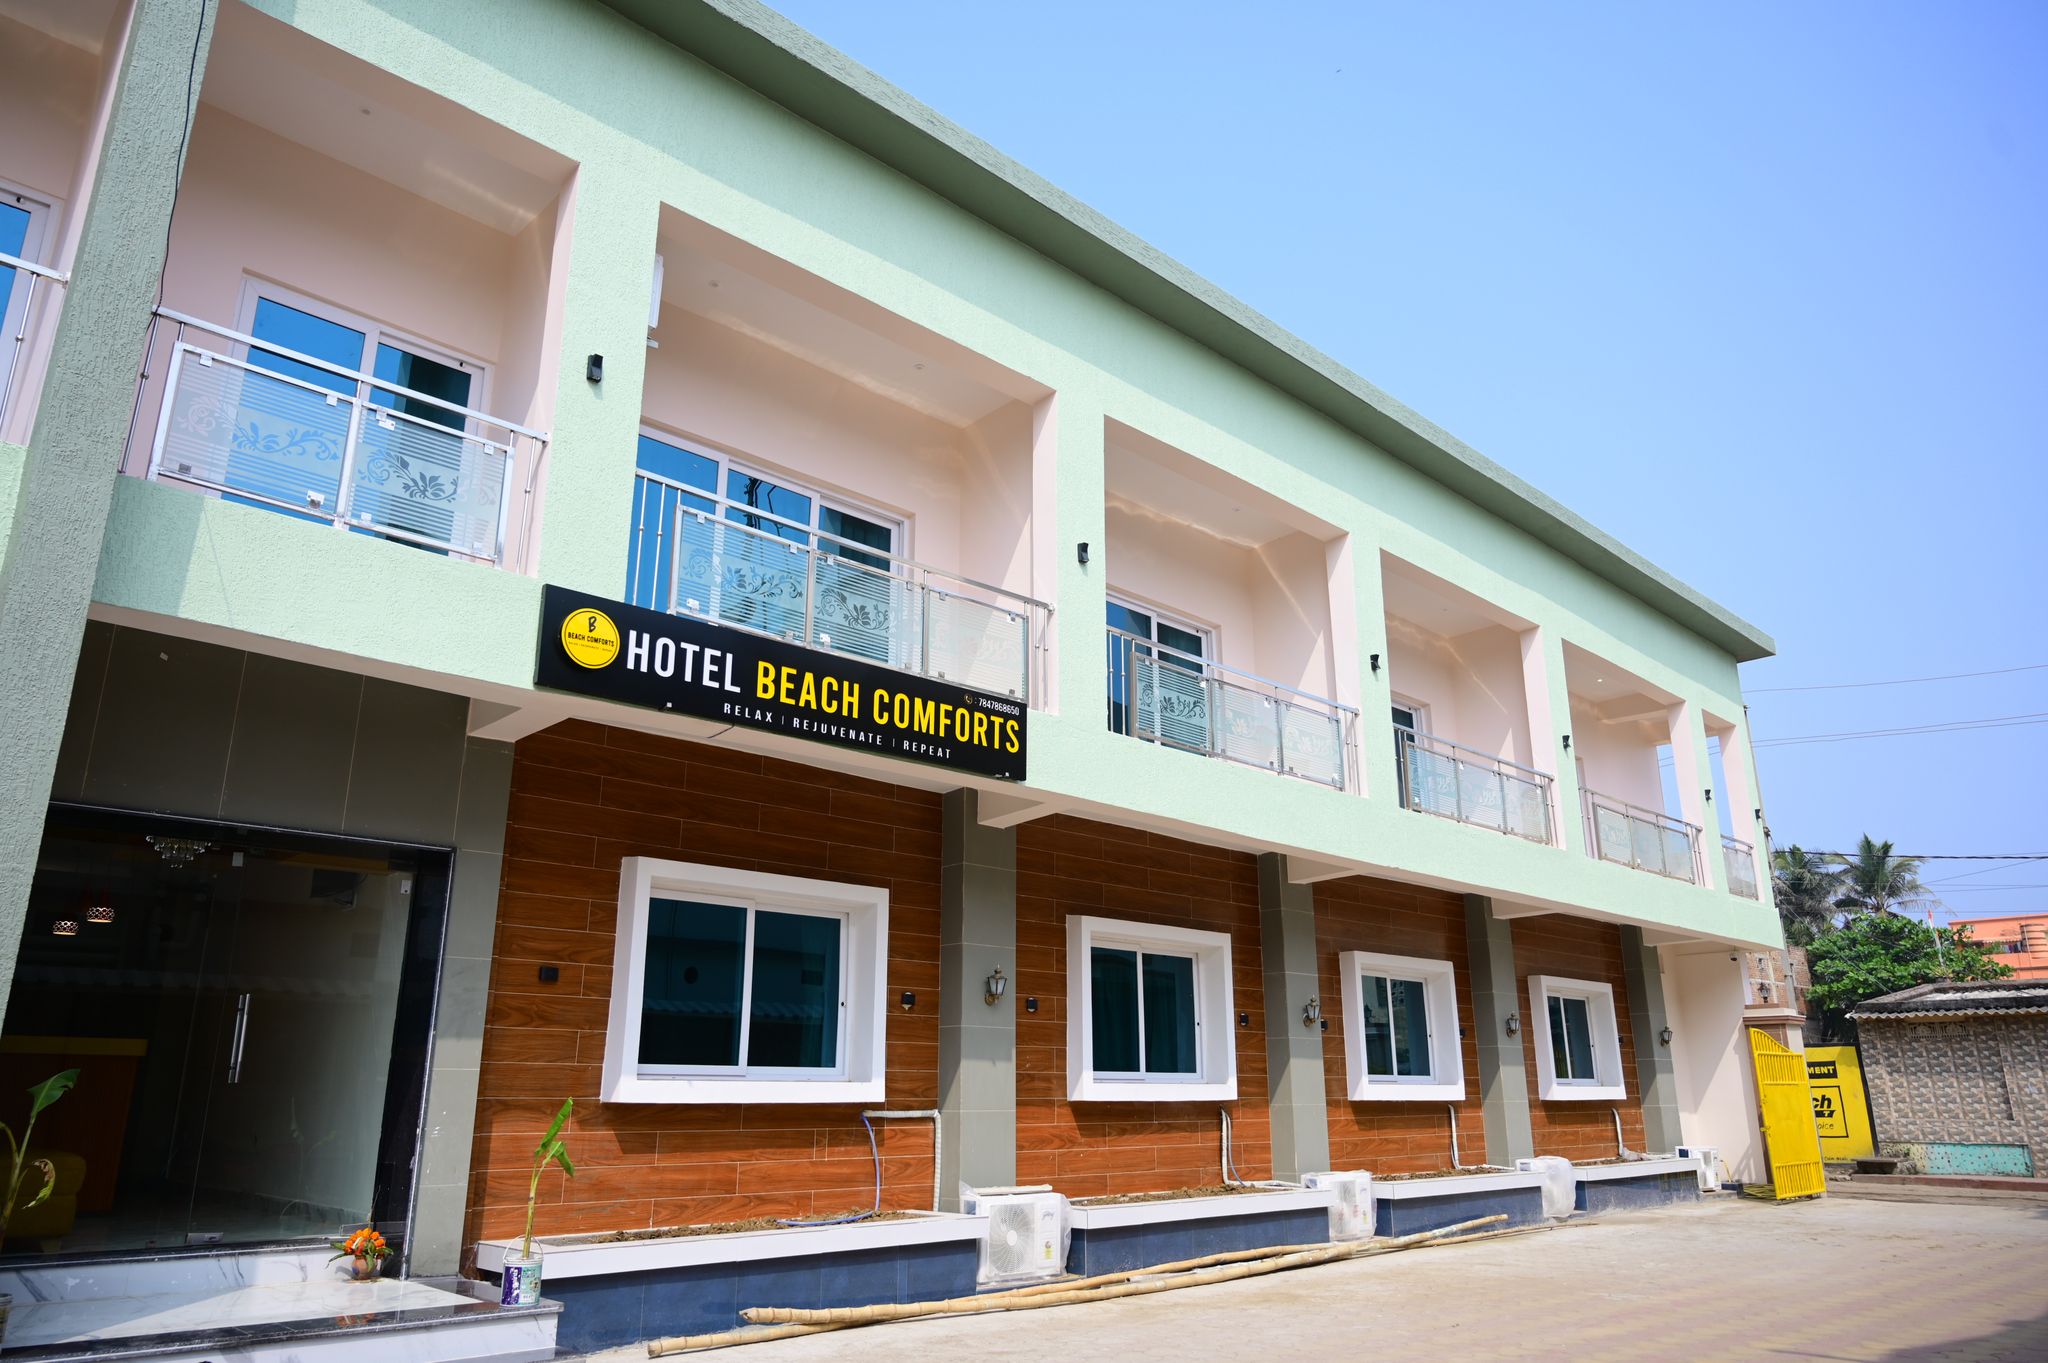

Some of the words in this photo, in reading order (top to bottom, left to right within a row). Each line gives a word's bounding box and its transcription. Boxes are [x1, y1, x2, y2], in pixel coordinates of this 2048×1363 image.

[567, 632, 586, 641] BEACH
[586, 635, 615, 648] COMFORTS
[626, 629, 741, 694] HOTEL
[756, 660, 860, 719] BEACH
[872, 688, 1020, 754] COMFORTS
[723, 702, 773, 723] RELAX
[793, 717, 883, 746] REJUVENATE
[903, 740, 951, 759] REPEAT
